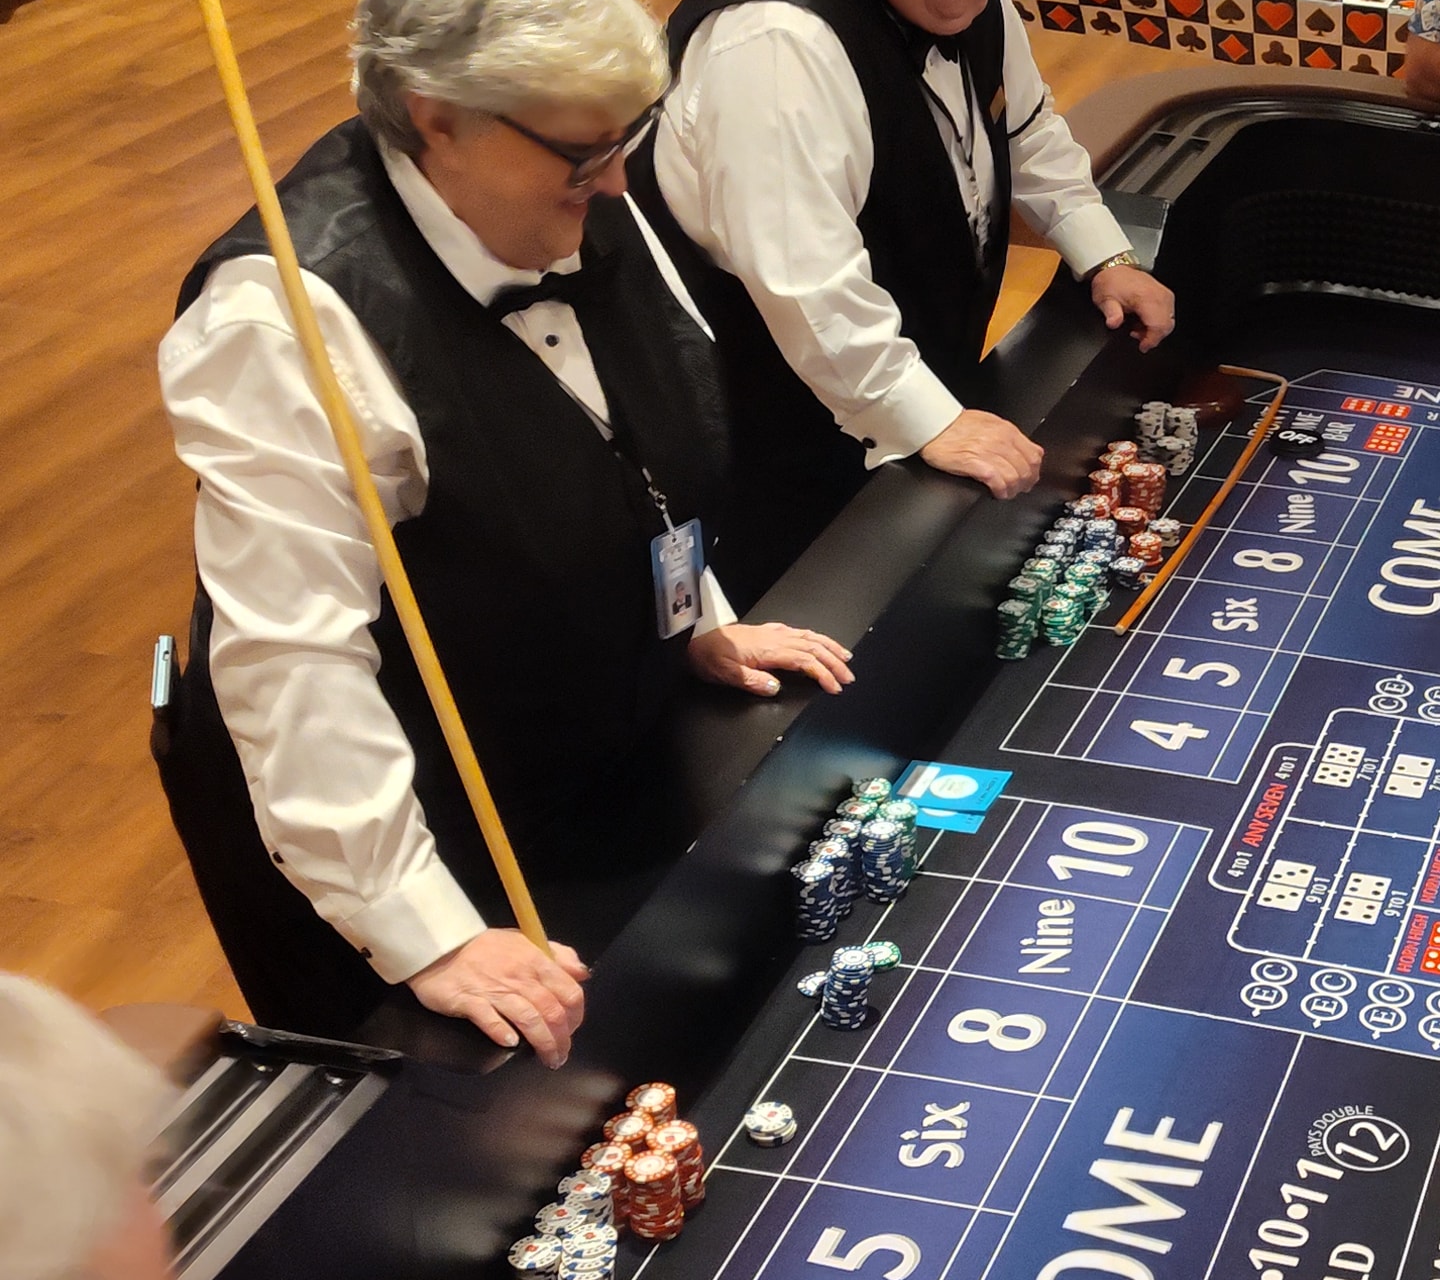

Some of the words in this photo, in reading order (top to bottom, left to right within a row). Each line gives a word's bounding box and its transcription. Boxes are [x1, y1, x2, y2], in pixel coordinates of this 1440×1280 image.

[1278, 430, 1318, 444] OFF
[1321, 422, 1356, 442] BAR
[1287, 453, 1360, 484] 10
[1278, 493, 1316, 534] Nine
[1233, 548, 1304, 572] 8
[1212, 597, 1259, 632] Six
[1162, 657, 1241, 688] 5
[1130, 719, 1209, 751] 4
[1254, 783, 1288, 821] SEVEN
[1241, 818, 1270, 848] ANY
[1047, 820, 1149, 882] 10
[1018, 896, 1077, 975] Nine
[1397, 939, 1421, 973] HORN
[1409, 913, 1429, 942] HIGH
[947, 1007, 1048, 1052] 8
[1313, 1104, 1375, 1130] DOUBLE
[898, 1101, 972, 1169] Six
[1307, 1129, 1326, 1157] PAYS
[1335, 1121, 1400, 1163] 12
